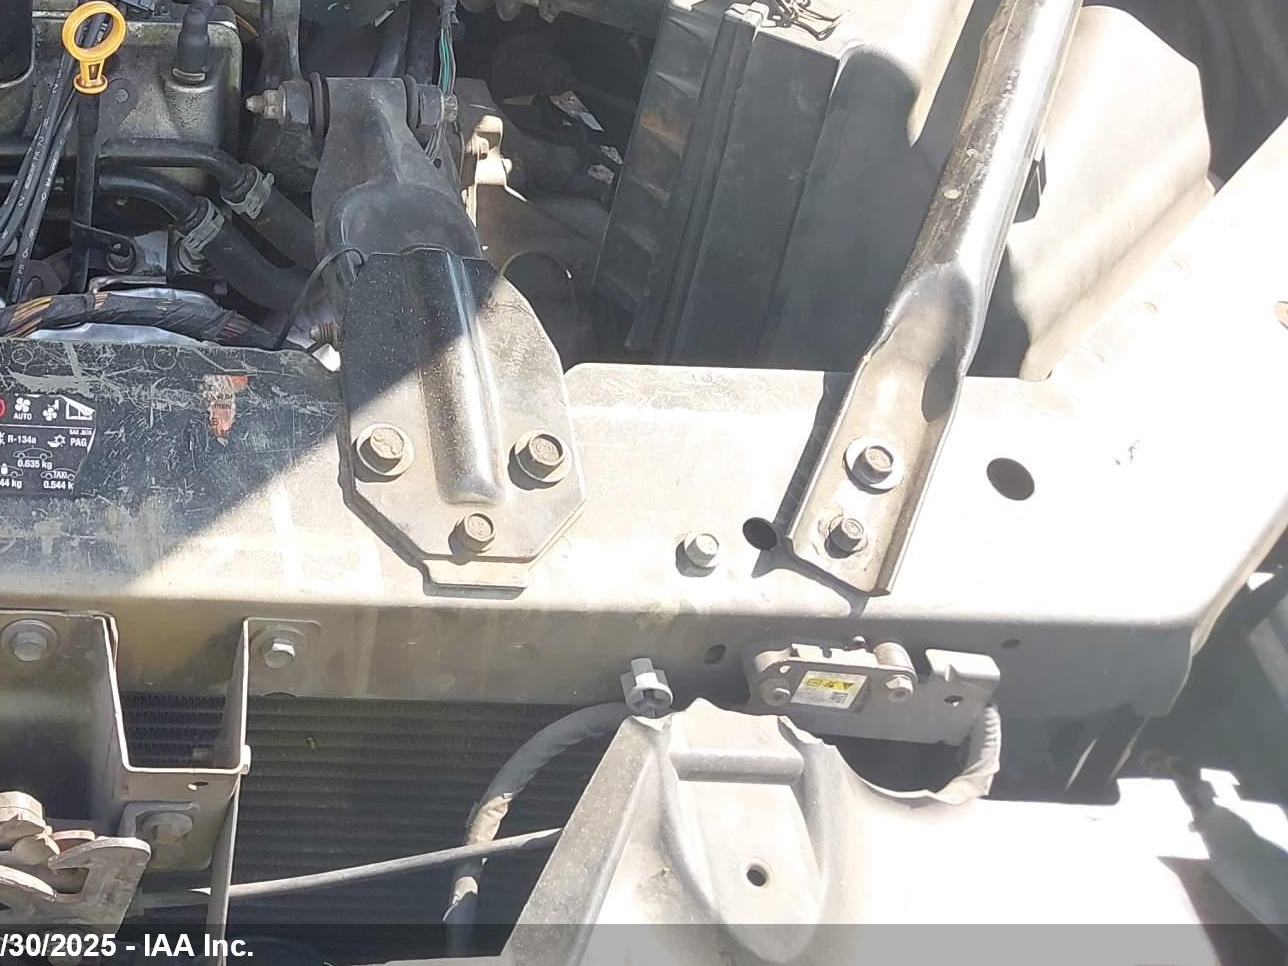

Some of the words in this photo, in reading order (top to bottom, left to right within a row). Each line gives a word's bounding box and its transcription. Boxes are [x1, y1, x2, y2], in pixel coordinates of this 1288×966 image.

[13, 412, 33, 421] AUTO
[8, 434, 37, 445] R-134a
[70, 437, 87, 447] PAG
[17, 459, 41, 468] 0.635
[41, 460, 53, 470] kg
[53, 470, 68, 479] TAXI
[11, 479, 22, 489] kg
[43, 480, 67, 489] 0.544
